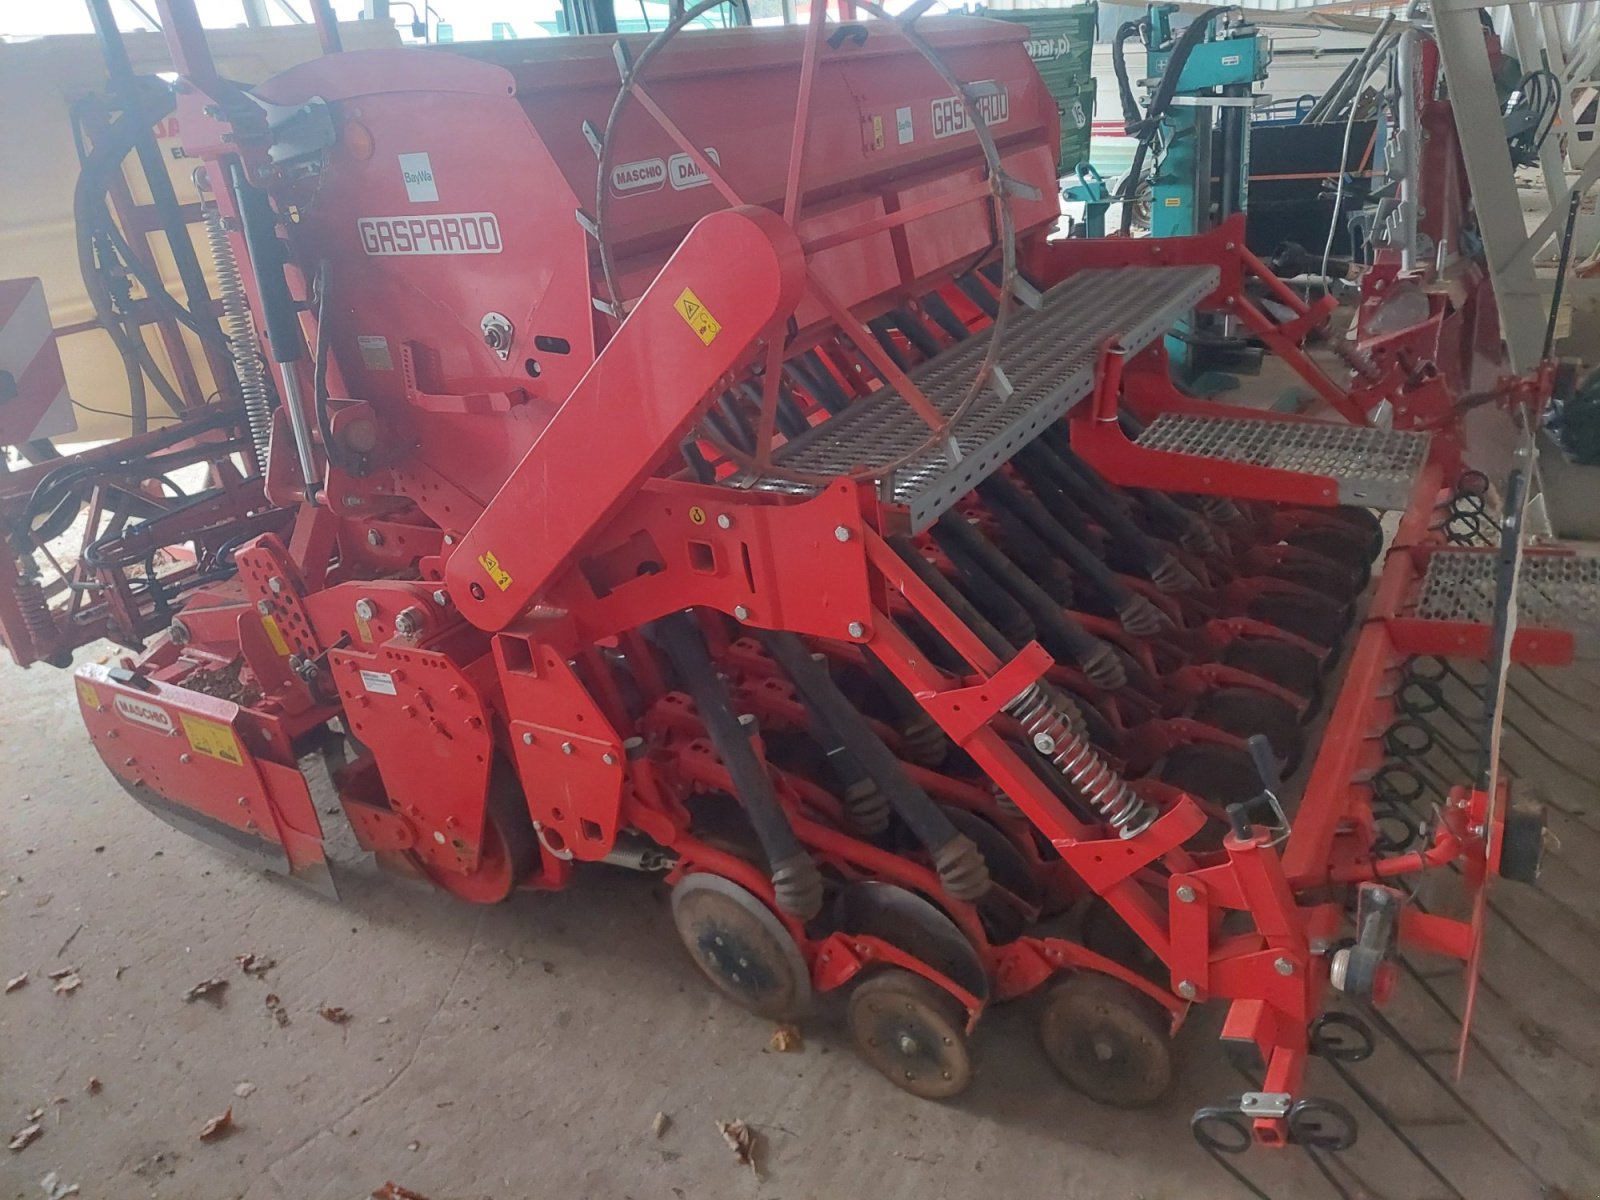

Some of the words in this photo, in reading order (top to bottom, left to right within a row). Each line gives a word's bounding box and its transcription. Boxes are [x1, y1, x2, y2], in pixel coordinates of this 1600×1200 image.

[404, 170, 432, 184] BayWa
[616, 165, 662, 184] MASCHIO
[360, 216, 500, 253] GASPARDO
[118, 700, 168, 725] MASCHIO
